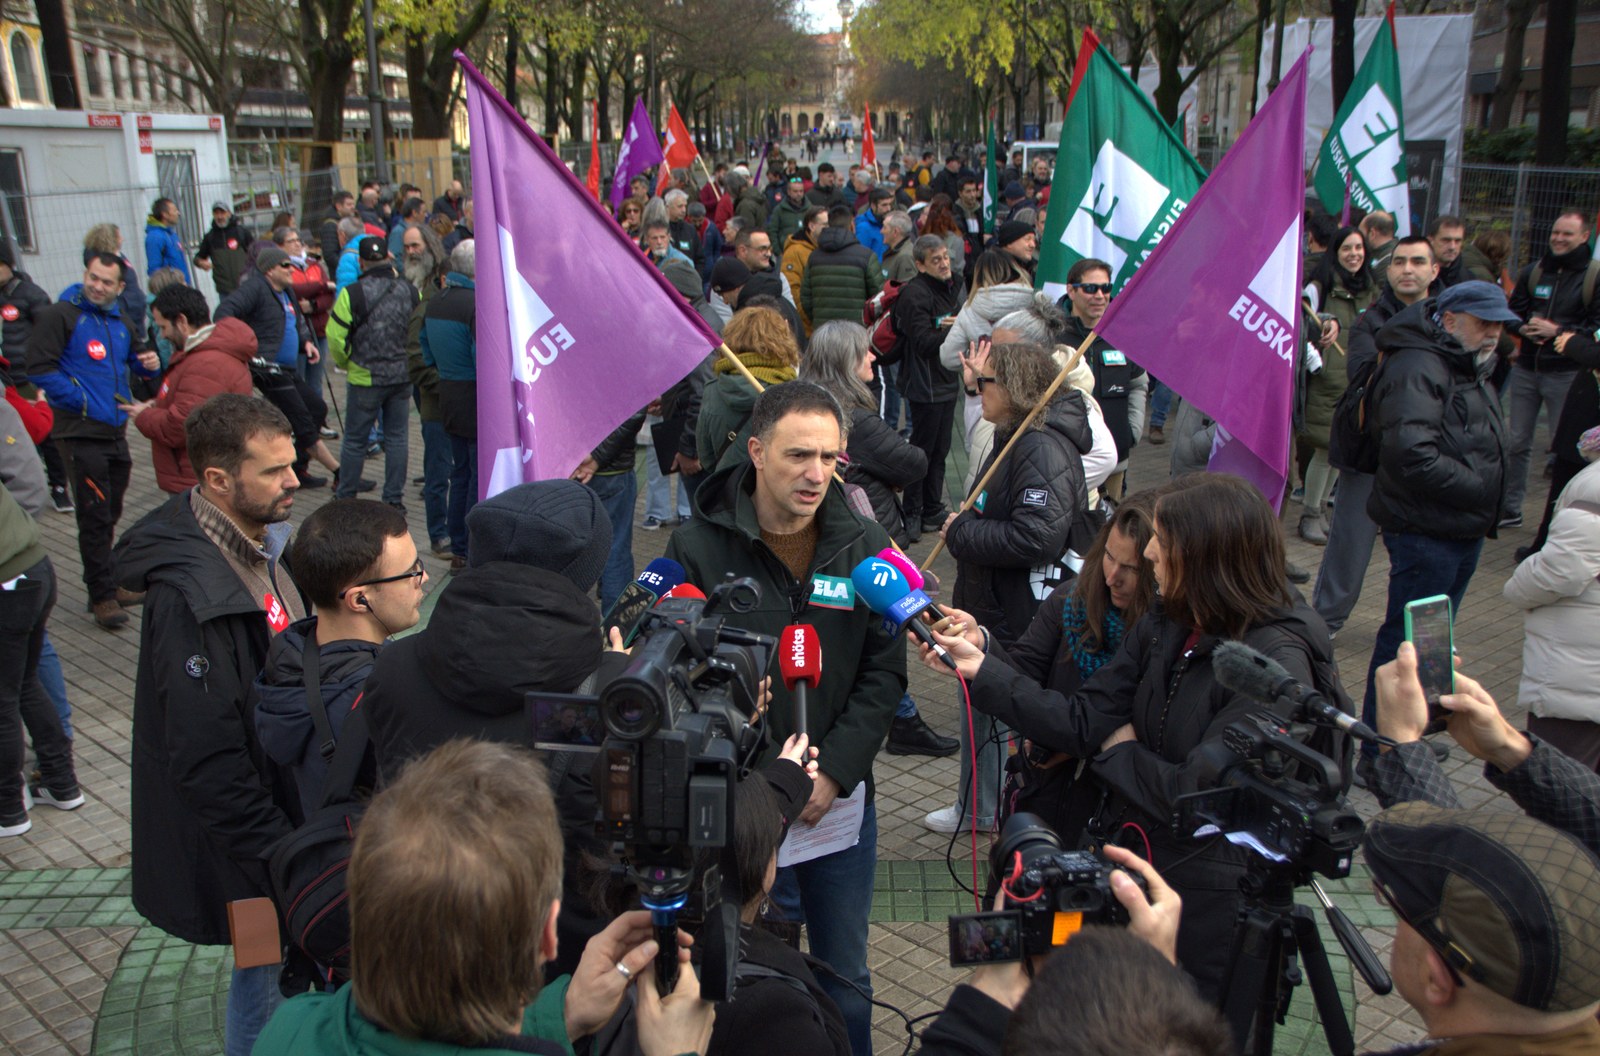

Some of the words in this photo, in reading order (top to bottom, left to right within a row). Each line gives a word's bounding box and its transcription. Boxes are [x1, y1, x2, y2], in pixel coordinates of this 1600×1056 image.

[1329, 134, 1350, 184] EUSKA
[812, 578, 849, 599] ELA
[900, 596, 916, 609] radio
[905, 597, 927, 614] euskadi
